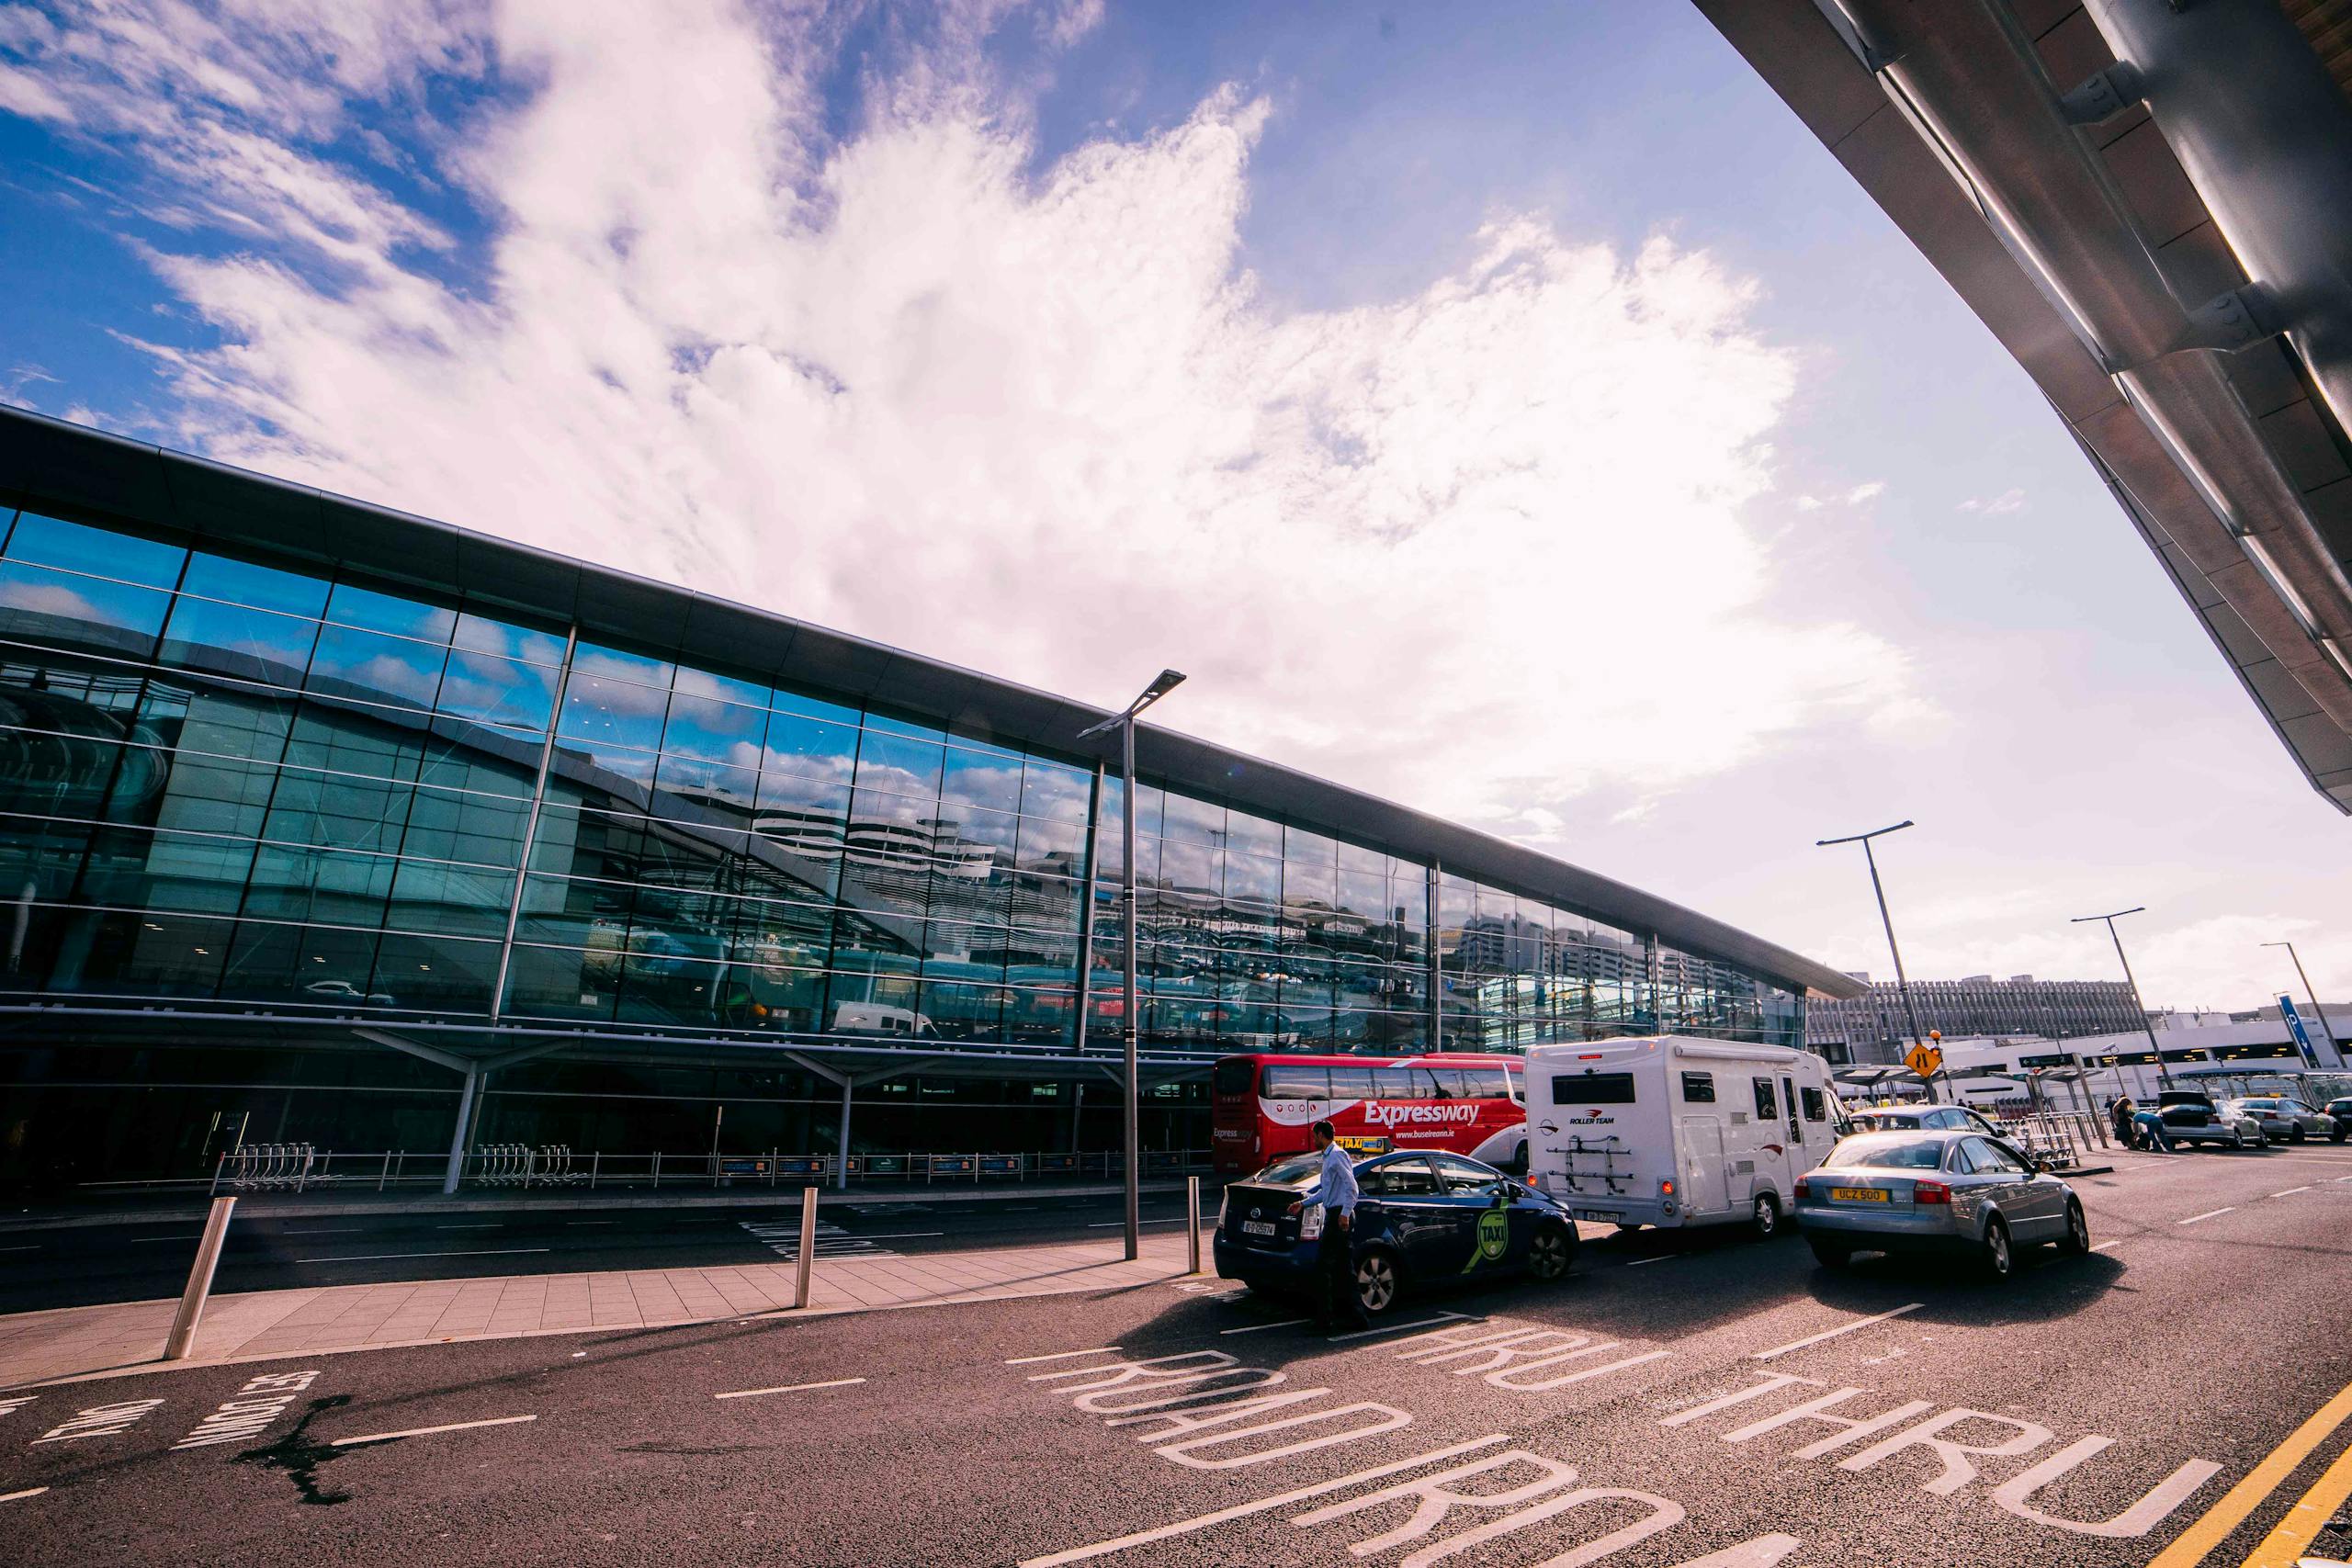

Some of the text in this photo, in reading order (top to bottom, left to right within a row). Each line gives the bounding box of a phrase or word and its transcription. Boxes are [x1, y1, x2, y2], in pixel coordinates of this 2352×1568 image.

[2288, 1014, 2298, 1031] P
[1364, 1100, 1480, 1129] Expressway
[1344, 1138, 1363, 1149] TAXI
[1396, 1129, 1455, 1139] www.buseireann.ie
[1839, 1190, 1880, 1201] UCZ 500
[1481, 1225, 1504, 1242] TAXI
[1329, 1311, 1671, 1392] THRU
[170, 1370, 321, 1450] SET DOWN
[1028, 1349, 1412, 1469] ROAD
[1657, 1370, 2223, 1538] THRU
